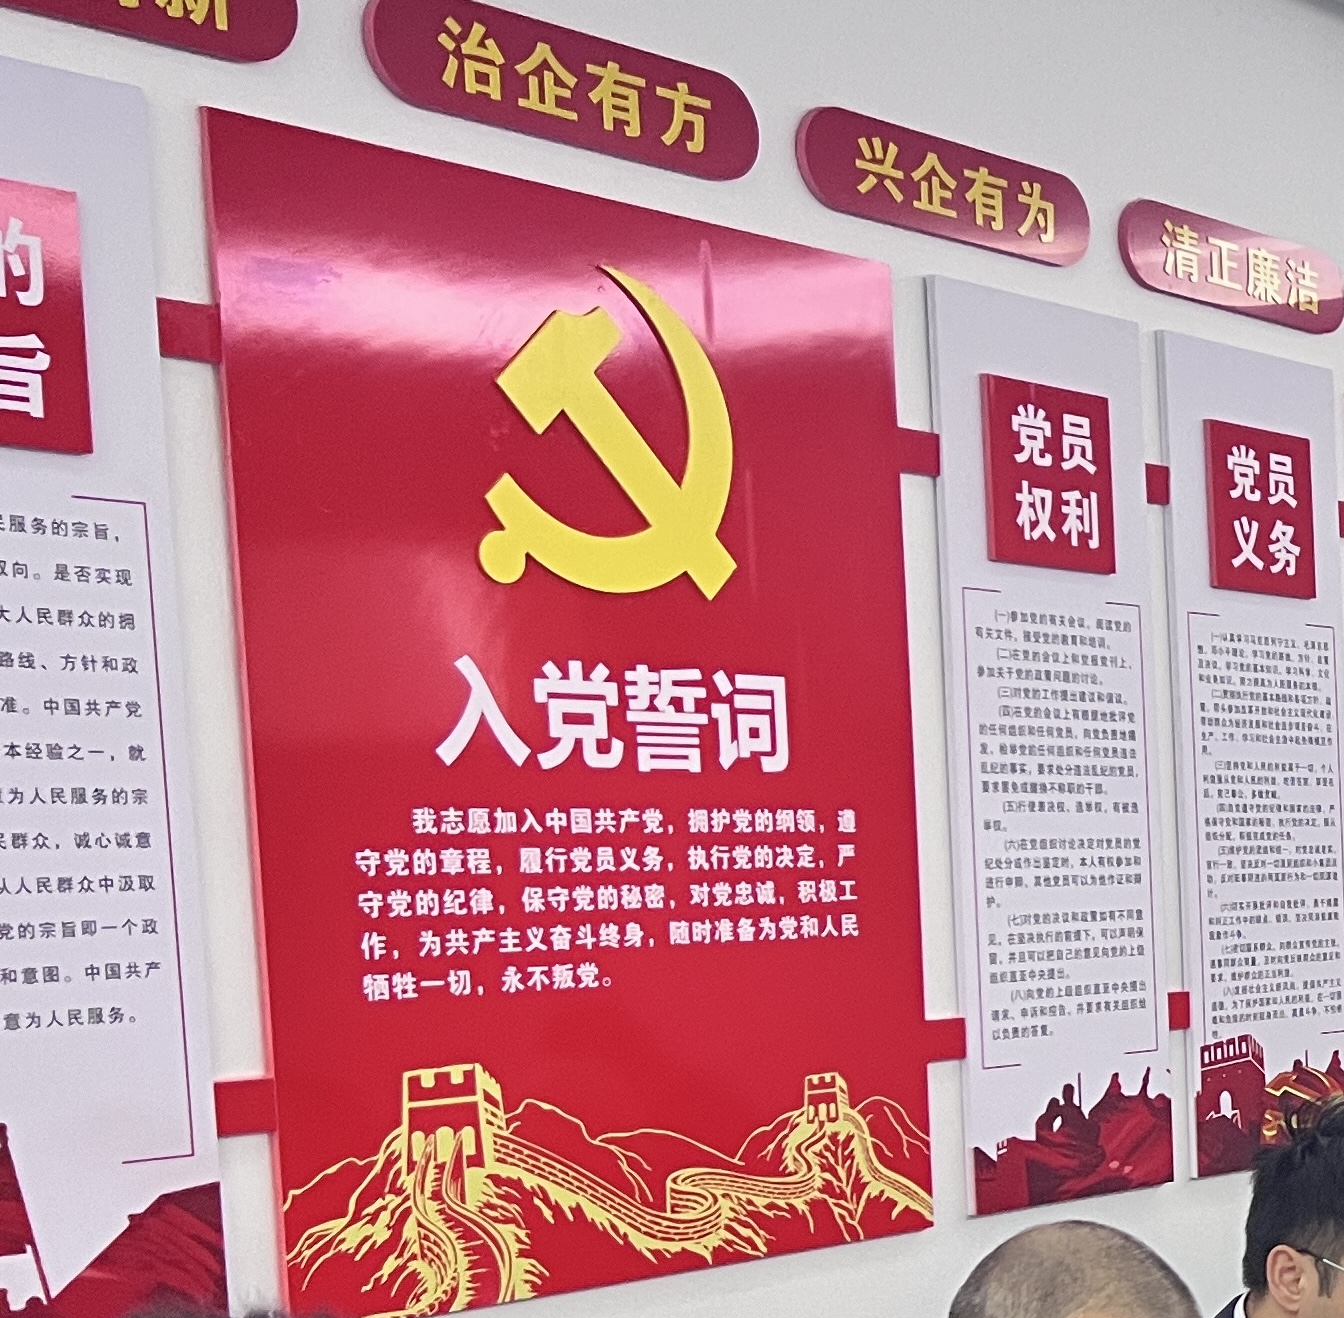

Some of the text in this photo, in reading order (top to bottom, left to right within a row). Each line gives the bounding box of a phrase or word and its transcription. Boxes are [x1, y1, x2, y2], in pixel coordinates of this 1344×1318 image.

[435, 13, 713, 155] 治企有方
[854, 135, 1057, 244] 兴企有为
[1160, 219, 1321, 316] 清正廉洁
[1011, 403, 1098, 477] 党员
[1227, 445, 1298, 508] 党员
[1014, 480, 1100, 551] 权利
[1231, 515, 1301, 578] 义务
[435, 654, 790, 774] 入党誓词
[0, 787, 149, 806] 为人民服务的宗
[412, 806, 858, 835] 我志愿加入中国共产党，拥护党的纲领，遵
[354, 845, 857, 878] 守党的章程，履行党员义务，执行党的决定，严
[357, 880, 859, 918] 守党的纪律，保守党的秘密，对党忠诚，积极工
[361, 913, 860, 961] 作，为共产主义奋斗终身，随时准备为党和人民
[363, 963, 612, 1003] 牺牲一切，永不叛党。
[3, 1006, 137, 1032] 意为人民服务。
